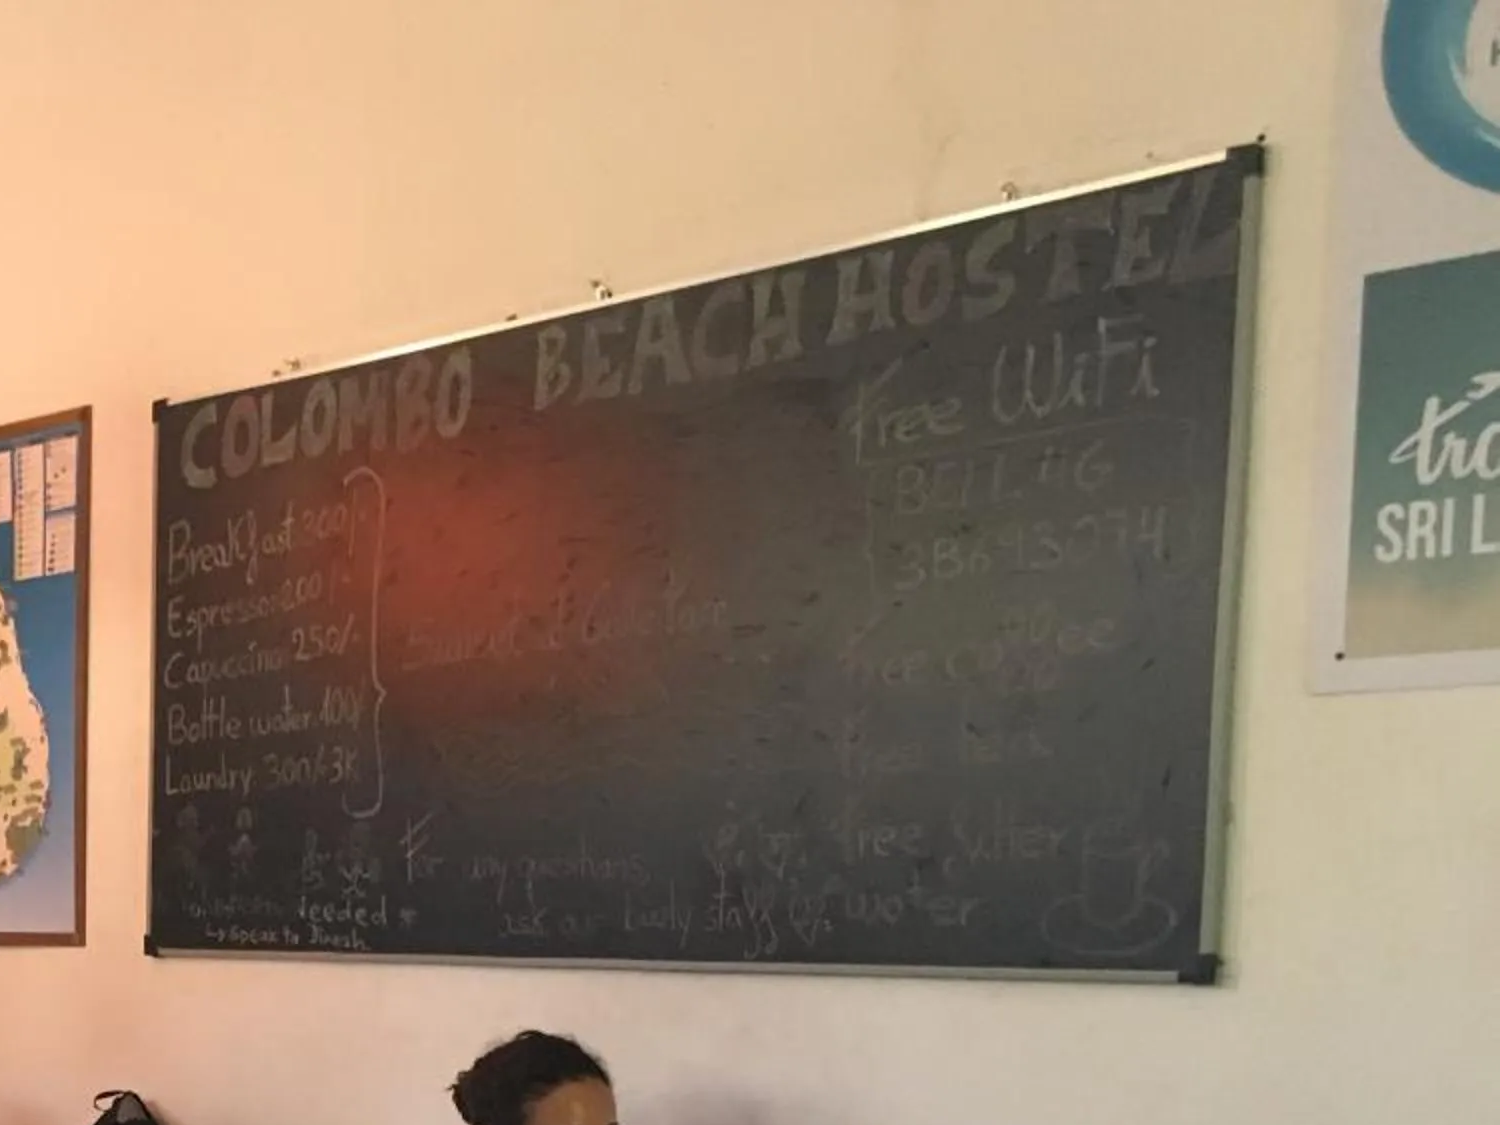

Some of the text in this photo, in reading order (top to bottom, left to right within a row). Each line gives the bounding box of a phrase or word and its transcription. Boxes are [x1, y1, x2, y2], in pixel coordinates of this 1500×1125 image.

[181, 345, 472, 489] COLOMBO
[535, 266, 804, 411] BEACH
[826, 170, 1240, 344] HOSTEL
[992, 314, 1161, 424] WiFi
[1374, 498, 1455, 563] SRI
[167, 695, 242, 746] Bottle
